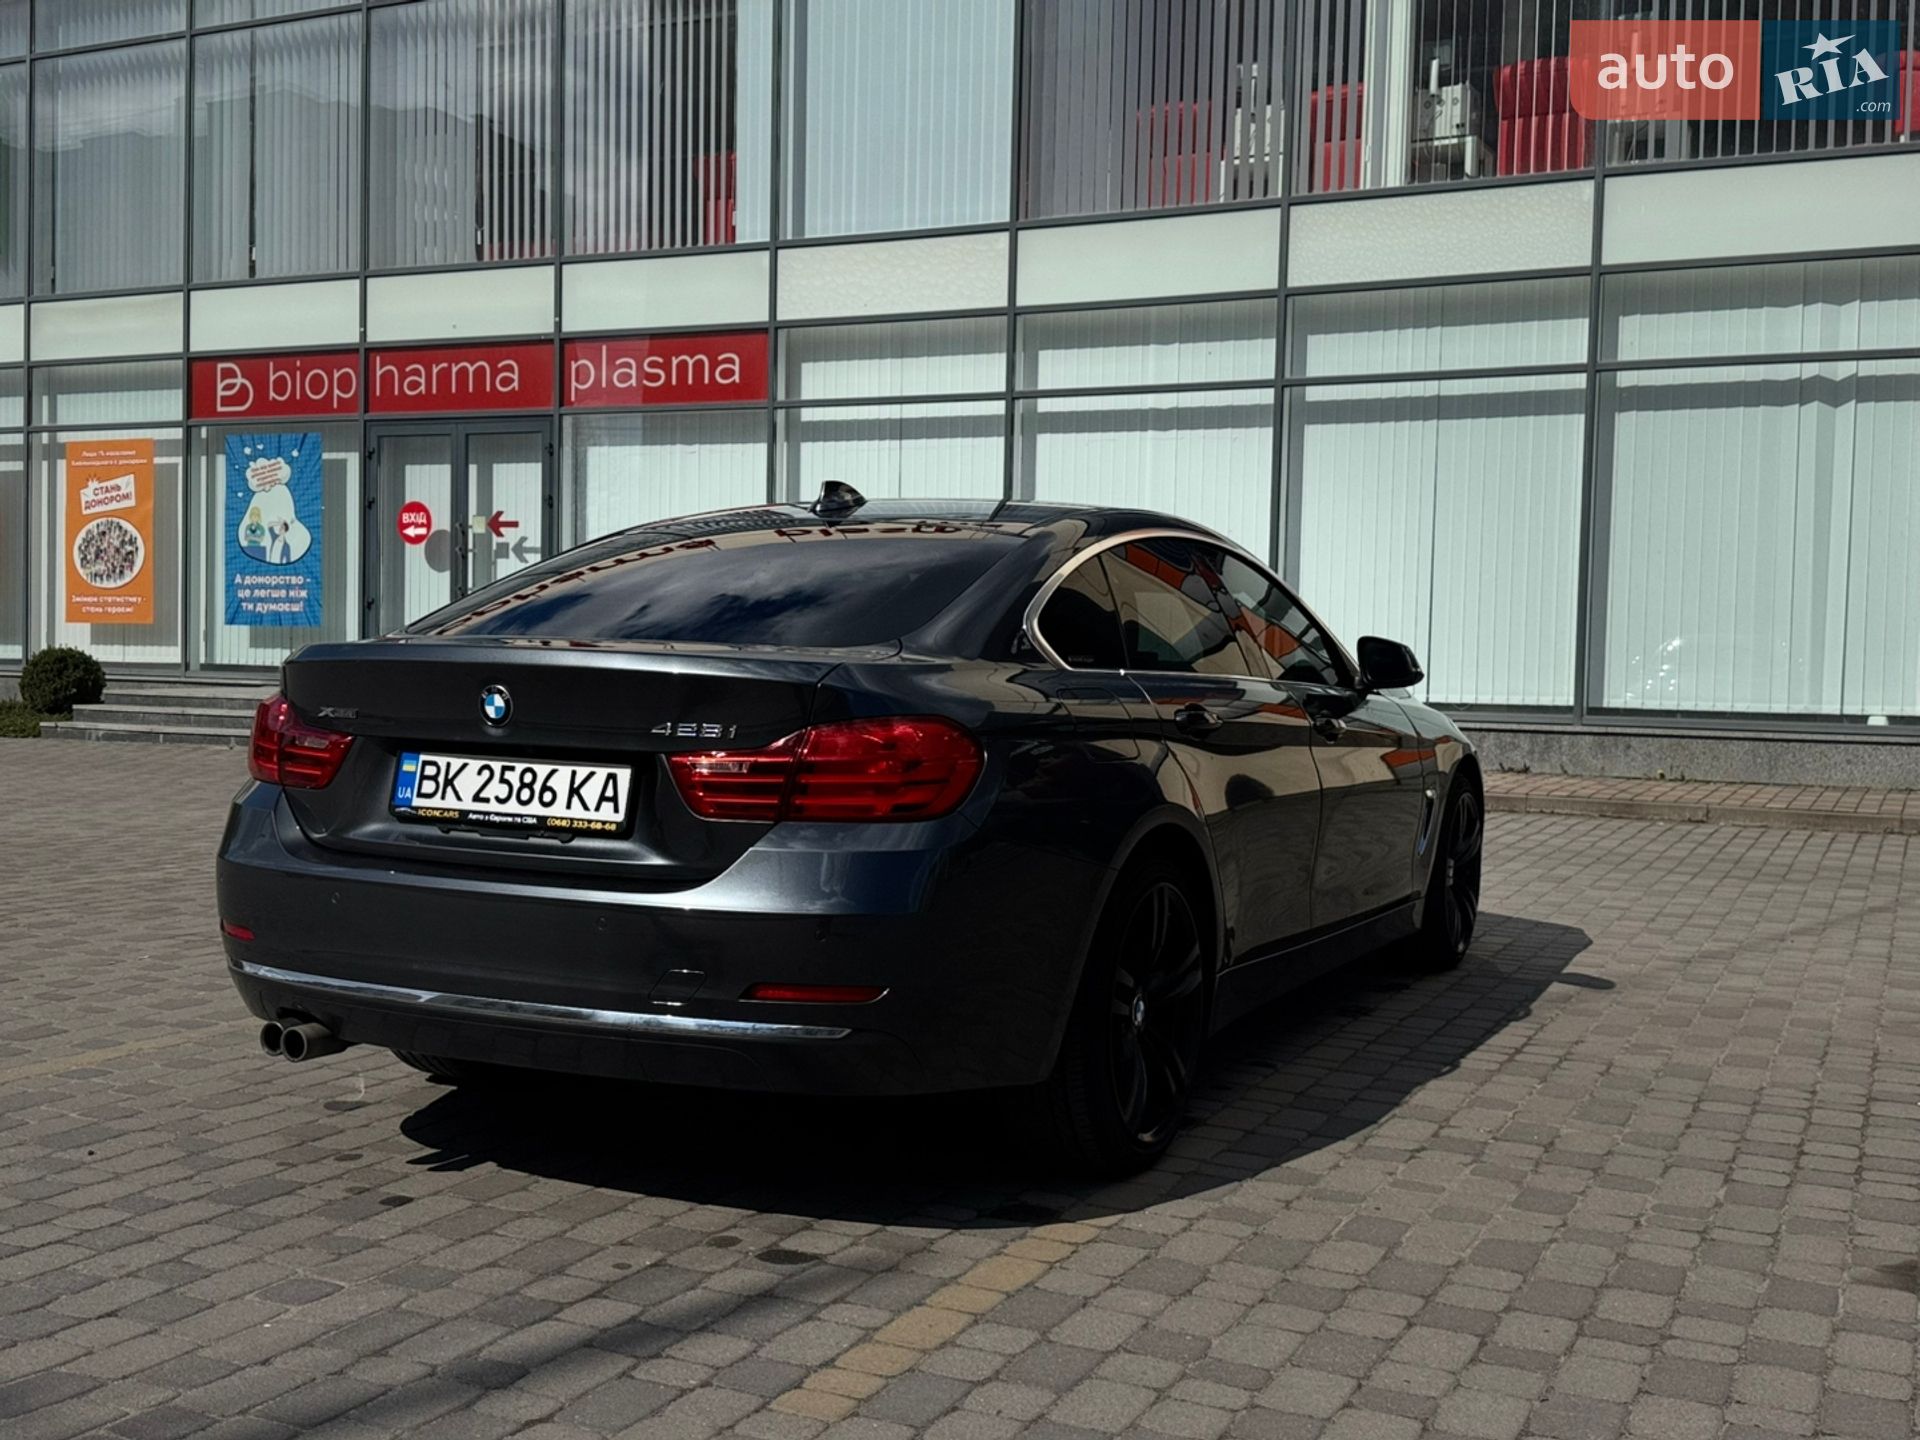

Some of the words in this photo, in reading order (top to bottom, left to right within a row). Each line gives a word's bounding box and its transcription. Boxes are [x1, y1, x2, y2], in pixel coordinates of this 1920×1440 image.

[571, 344, 741, 402] plasma
[93, 483, 122, 497] СТАНЬ
[84, 491, 133, 511] ДОНОРОМ!
[243, 575, 304, 586] донорство
[237, 589, 251, 599] це
[252, 589, 287, 598] легше
[289, 586, 308, 598] ніж
[241, 602, 254, 611] ти
[255, 600, 304, 614] думаєш!
[397, 786, 412, 800] UA
[416, 760, 470, 803] BK
[471, 763, 559, 809] 2586
[565, 769, 620, 815] KA
